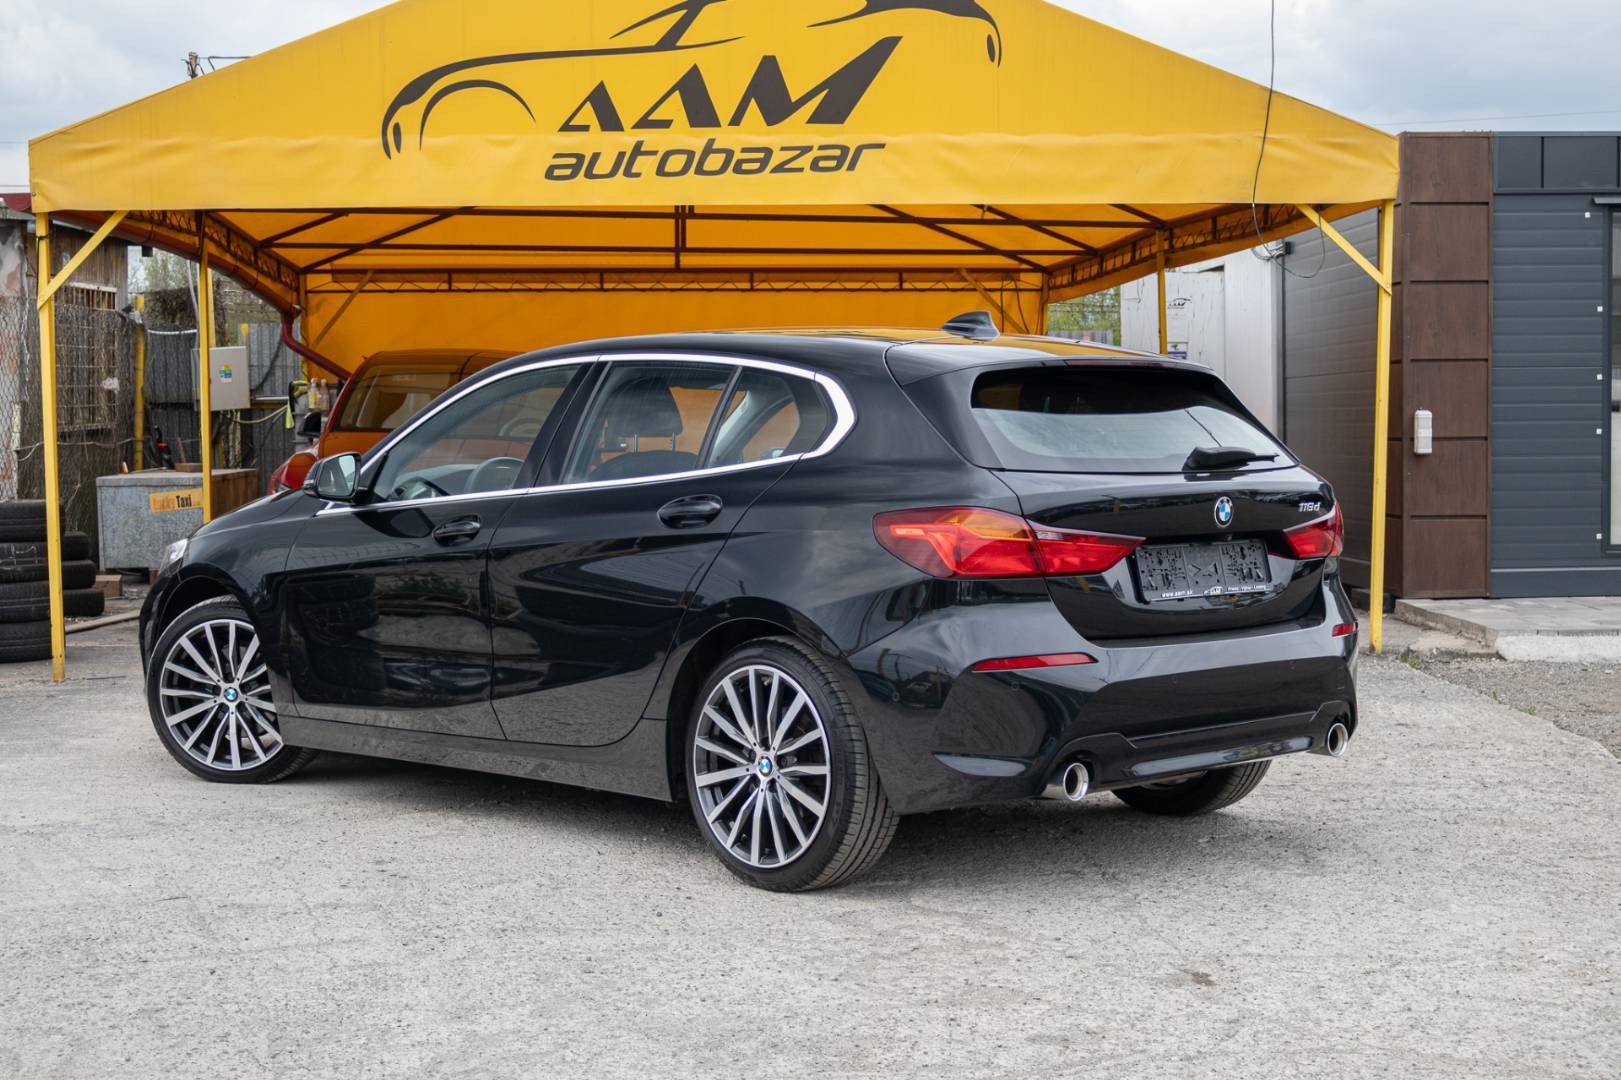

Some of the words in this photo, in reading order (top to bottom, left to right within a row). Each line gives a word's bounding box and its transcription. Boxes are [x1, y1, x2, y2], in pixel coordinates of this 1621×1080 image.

[557, 35, 903, 133] AAM
[544, 138, 886, 182] autobazar
[176, 494, 192, 508] Taxi
